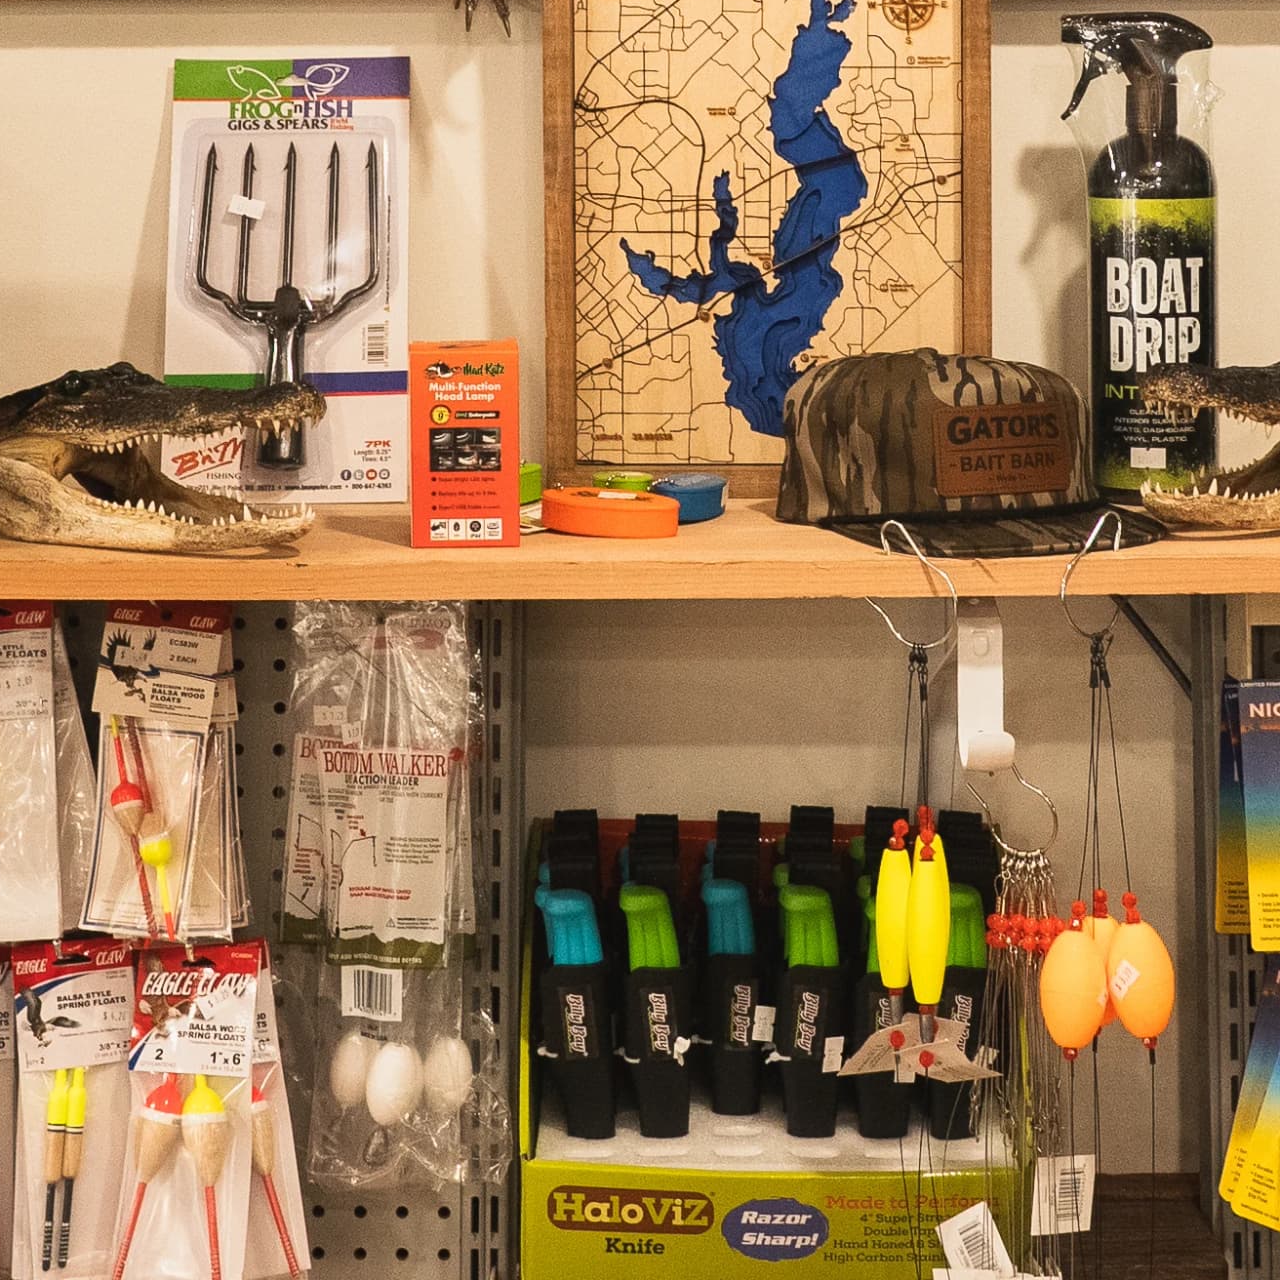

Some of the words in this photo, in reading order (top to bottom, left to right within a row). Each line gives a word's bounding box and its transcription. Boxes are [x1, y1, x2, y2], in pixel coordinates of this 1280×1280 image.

[228, 120, 260, 130] GIGS
[264, 120, 275, 130] &
[277, 119, 328, 129] SPEARS
[1106, 257, 1204, 315] BOAT
[1109, 317, 1201, 373] DRIP
[429, 382, 501, 391] Multi-Function
[435, 392, 463, 400] Head
[466, 393, 495, 401] Lamp
[961, 455, 1005, 472] BAIT
[1012, 452, 1055, 469] BARN
[15, 611, 47, 625] CLAW
[114, 608, 142, 621] EAGLE
[190, 616, 217, 629] CLAW
[7, 649, 47, 659] FLOATS
[150, 694, 182, 703] FLOATS
[323, 750, 373, 776] BOTTOM
[379, 753, 447, 777] WALKER
[353, 775, 388, 785] ACTION
[389, 775, 419, 786] LEADER
[16, 959, 46, 974] EAGLE
[95, 950, 125, 966] CLAW
[142, 972, 194, 996] EAGLE
[198, 971, 252, 997] CLAW
[56, 994, 83, 1003] BALSA
[85, 990, 111, 999] STYLE
[57, 1000, 92, 1010] SPRING
[93, 996, 127, 1007] FLOATS
[177, 1030, 206, 1040] SPRING
[208, 1032, 246, 1043] FLOATS
[155, 1048, 164, 1061] 2
[825, 1195, 885, 1210] Made
[890, 1196, 909, 1209] to
[741, 1211, 812, 1227] Razor
[864, 1226, 908, 1237] Double
[605, 1237, 665, 1256] Knife
[742, 1232, 818, 1250] Sharp!
[834, 1239, 869, 1249] Hand
[872, 1239, 914, 1249] Honed
[824, 1252, 853, 1263] High
[856, 1252, 904, 1262] Carbon
